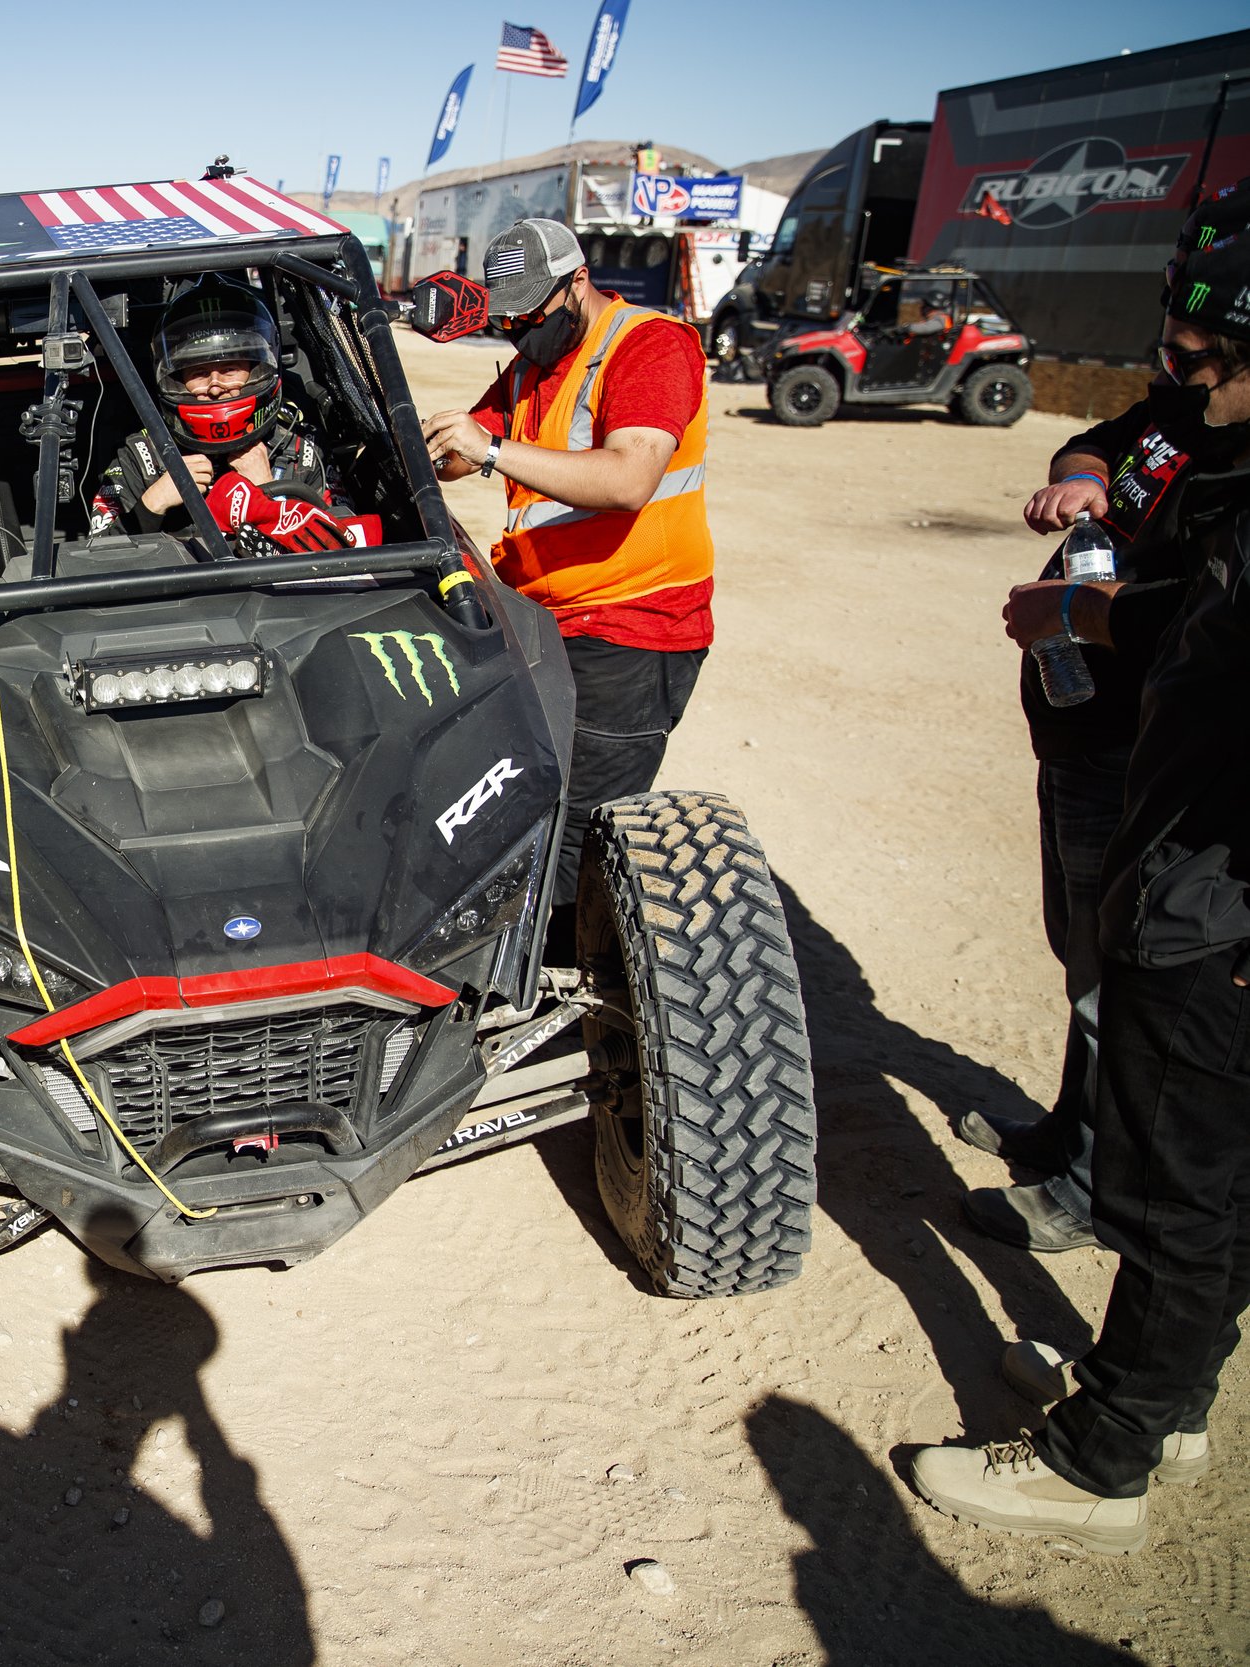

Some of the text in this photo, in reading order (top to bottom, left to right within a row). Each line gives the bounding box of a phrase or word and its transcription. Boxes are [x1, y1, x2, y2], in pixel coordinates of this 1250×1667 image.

[975, 164, 1169, 203] RUBICON
[187, 327, 236, 339] MONSTER
[134, 441, 156, 475] sparco
[434, 757, 524, 846] RZR
